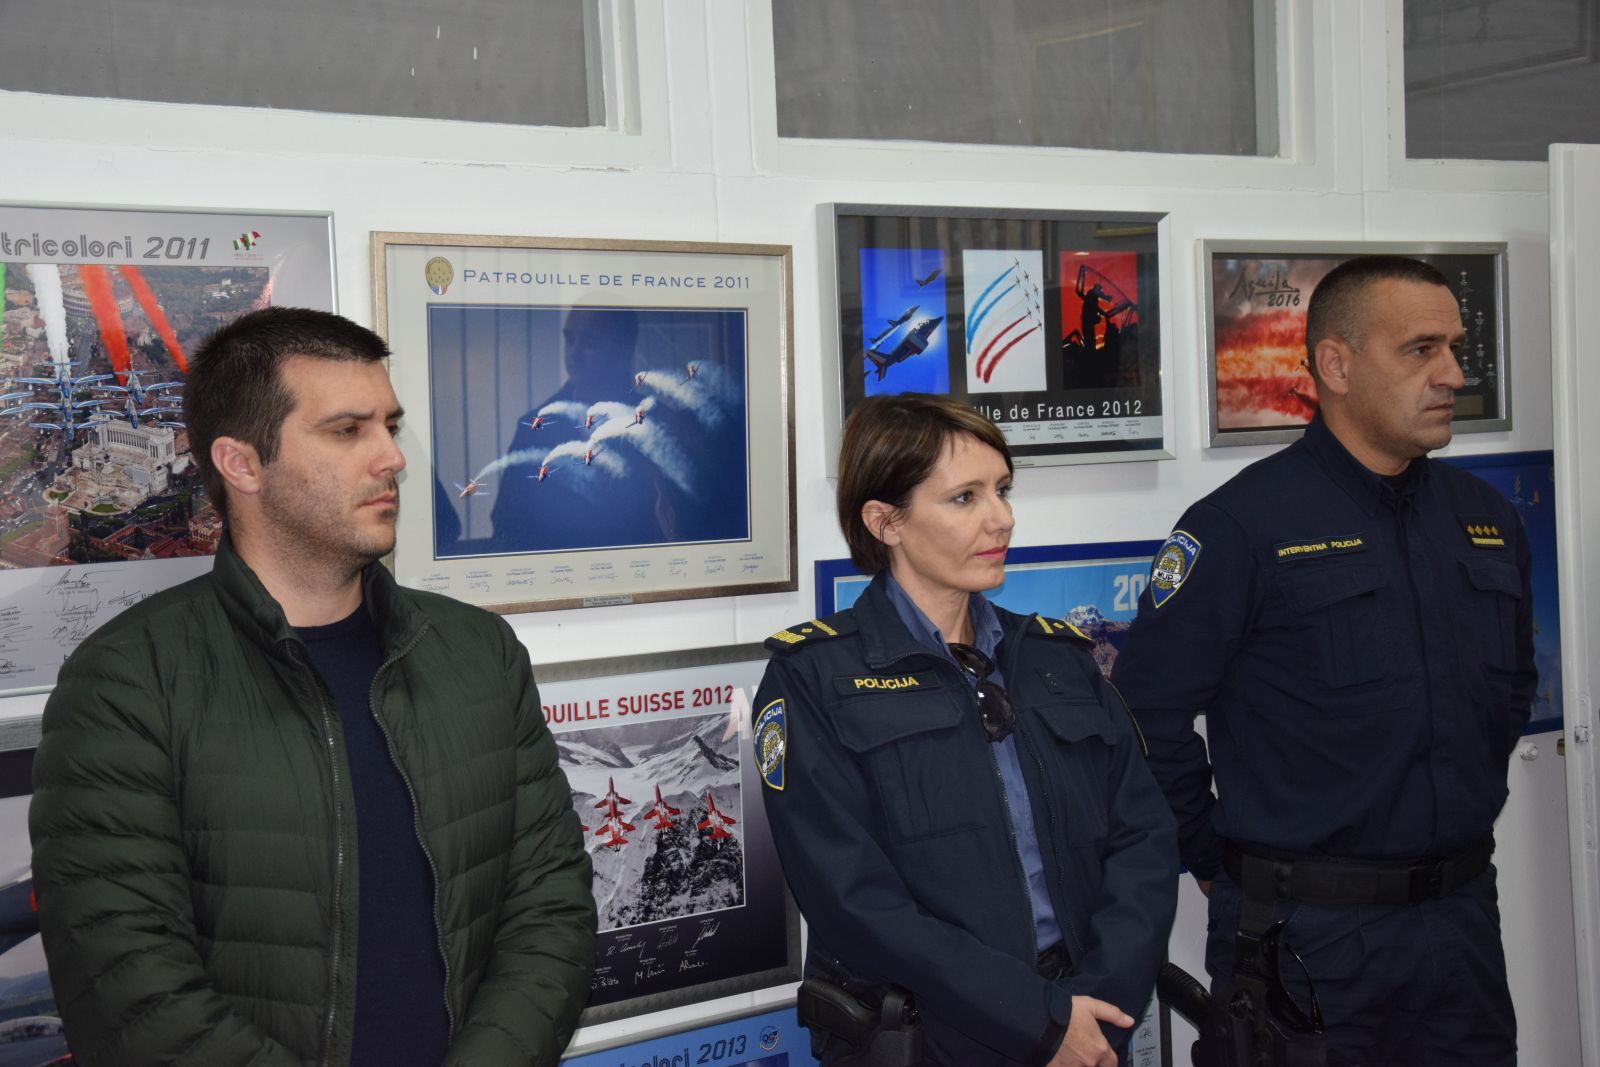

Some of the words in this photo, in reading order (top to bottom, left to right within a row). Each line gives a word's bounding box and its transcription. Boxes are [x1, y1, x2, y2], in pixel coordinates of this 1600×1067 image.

[1, 232, 133, 259] tricolori
[143, 236, 210, 260] 2011
[713, 276, 750, 289] 2011
[1267, 293, 1300, 308] 2016
[1009, 403, 1030, 420] de
[1037, 402, 1096, 418] France
[1102, 400, 1142, 416] 2012
[1331, 538, 1363, 549] POLICIJA
[854, 676, 920, 690] POLICIJA
[617, 690, 685, 716] SUISSE
[692, 685, 734, 708] 2012
[696, 1035, 748, 1065] 2013
